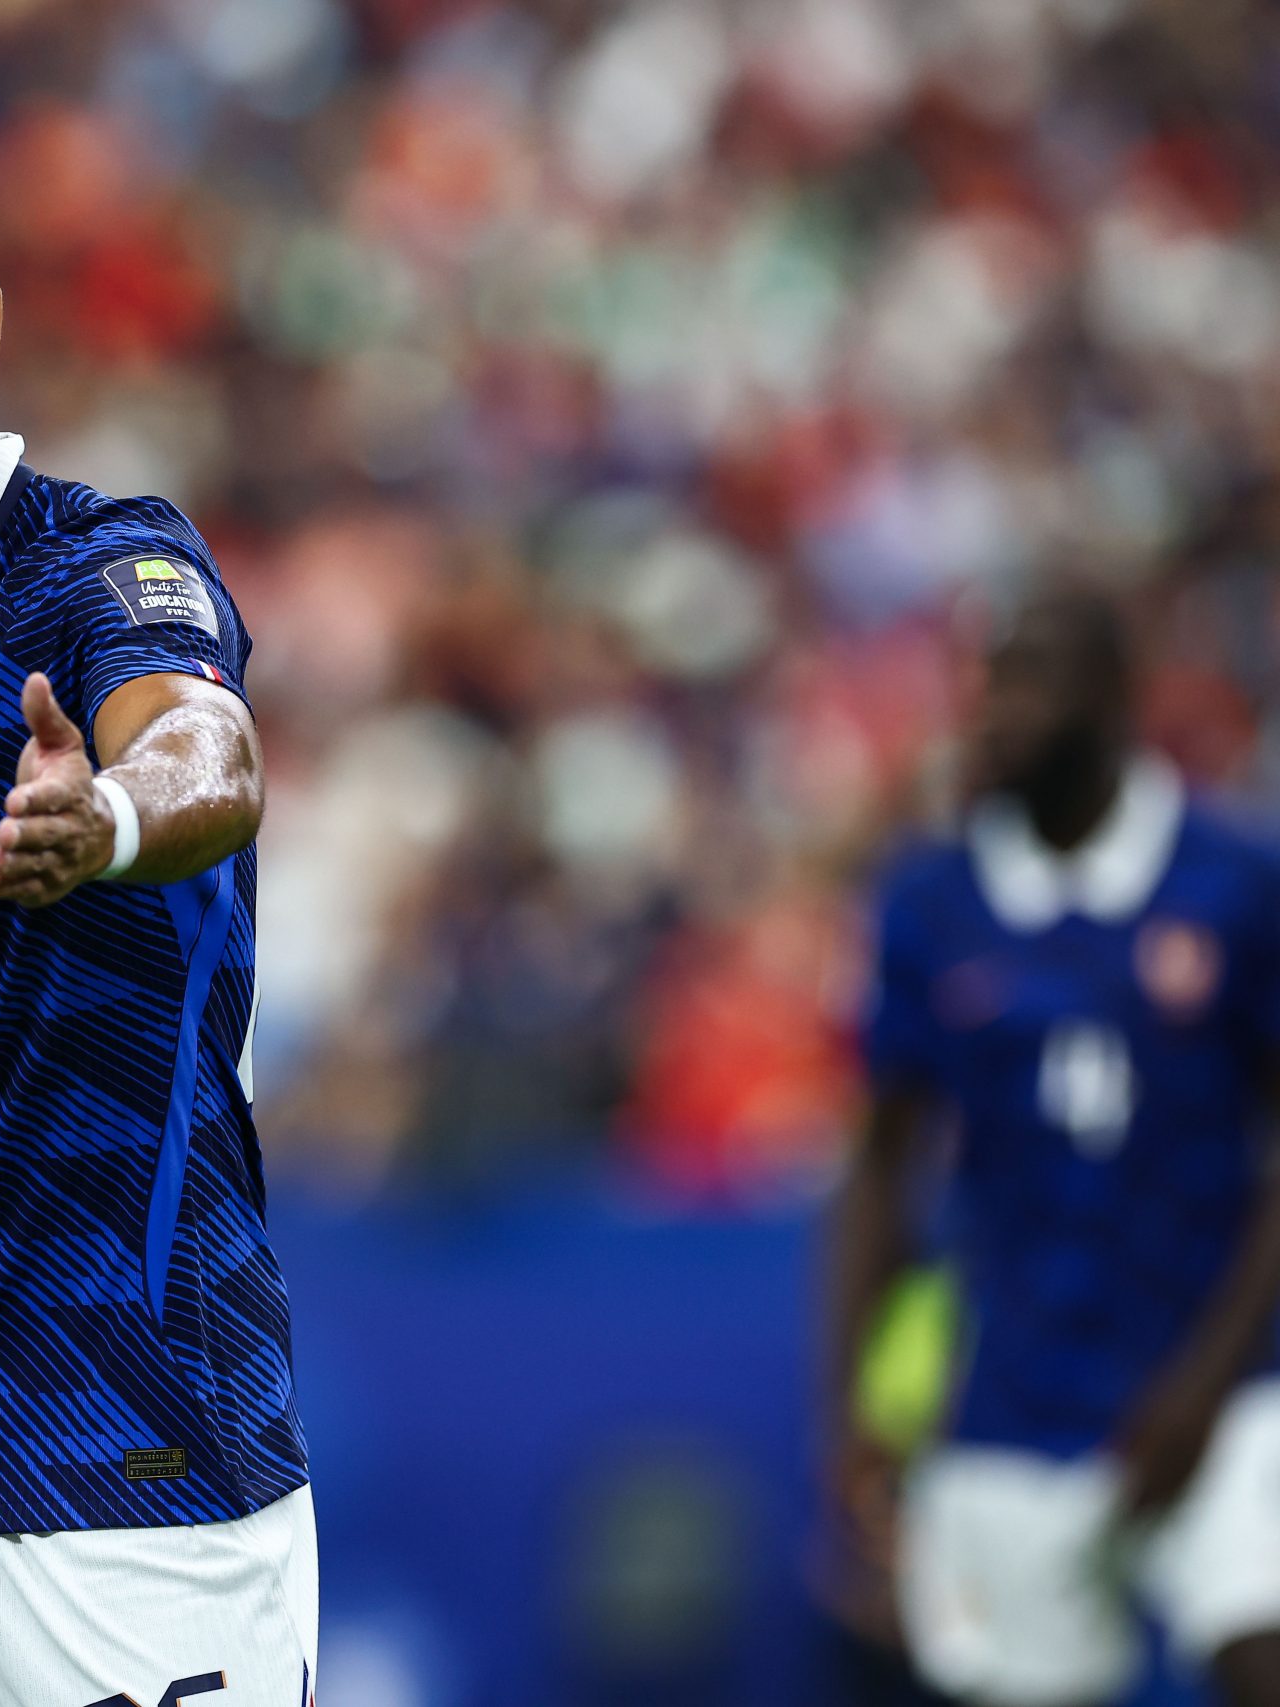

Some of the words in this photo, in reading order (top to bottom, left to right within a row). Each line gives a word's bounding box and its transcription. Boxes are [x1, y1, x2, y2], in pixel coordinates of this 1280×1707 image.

[141, 581, 174, 595] Unite
[174, 583, 192, 595] For
[138, 594, 206, 615] EDUCATION
[166, 608, 192, 617] FIFA
